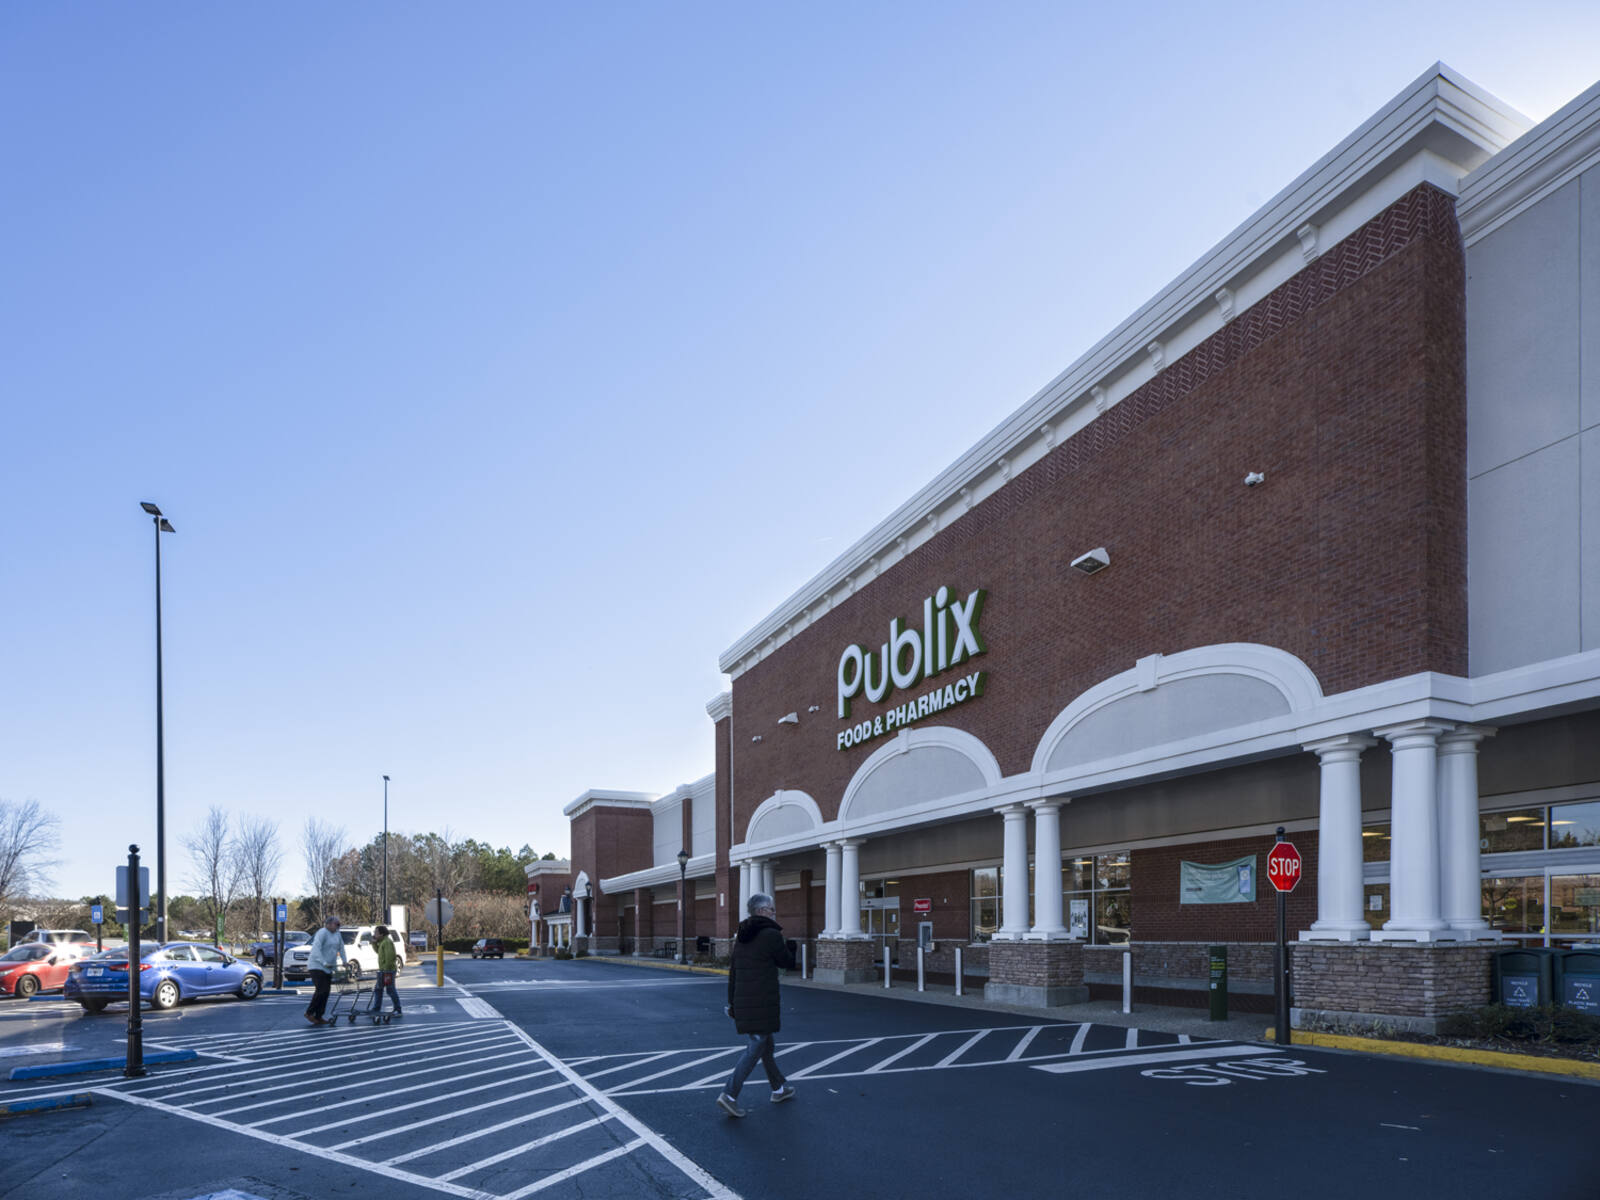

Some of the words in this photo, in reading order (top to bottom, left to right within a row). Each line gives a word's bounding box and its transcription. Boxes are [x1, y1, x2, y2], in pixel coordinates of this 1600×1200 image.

[837, 585, 984, 720] Publix
[837, 720, 872, 751] FOOD
[873, 715, 884, 737] &
[886, 671, 982, 732] PHARMACY
[1270, 857, 1300, 877] STOP
[1140, 1057, 1329, 1087] STOP
